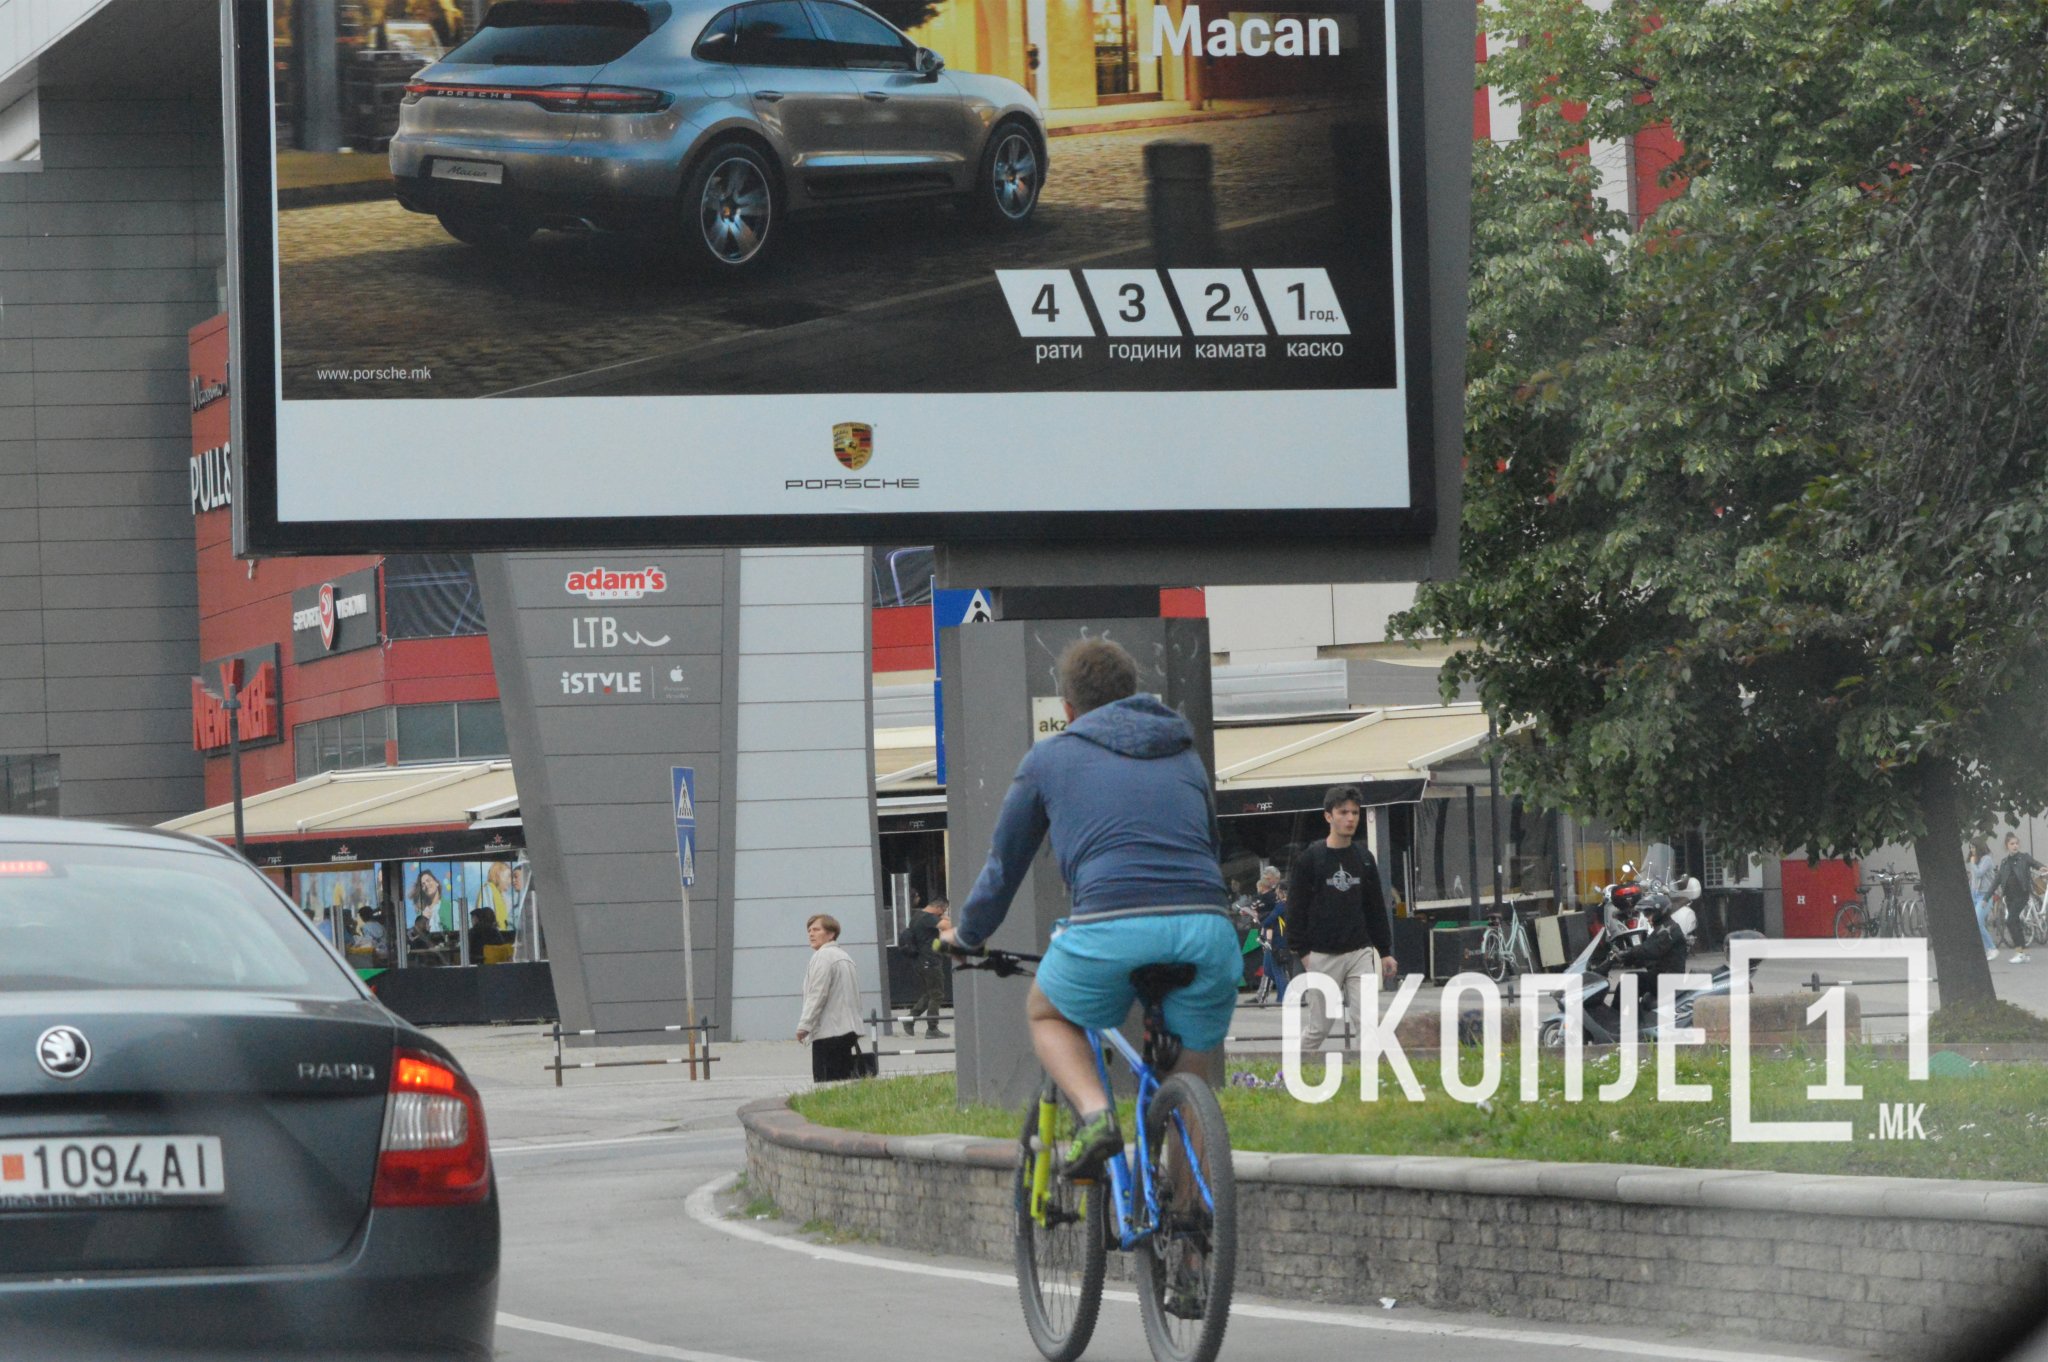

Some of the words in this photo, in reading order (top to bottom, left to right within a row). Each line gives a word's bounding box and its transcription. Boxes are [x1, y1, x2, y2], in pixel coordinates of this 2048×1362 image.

[1152, 5, 1340, 57] Macan
[437, 89, 512, 99] PORSCHE
[1031, 284, 1060, 322] 4
[1118, 283, 1147, 323] 3
[1036, 343, 1083, 363] рати
[1109, 342, 1182, 361] години
[1195, 342, 1267, 358] камата
[1287, 341, 1344, 357] каско
[317, 365, 432, 382] www.porsche.mk
[785, 478, 919, 490] PORSCHE
[572, 616, 618, 648] LTB
[560, 671, 641, 694] iSTYLE
[298, 1063, 375, 1080] RAPID
